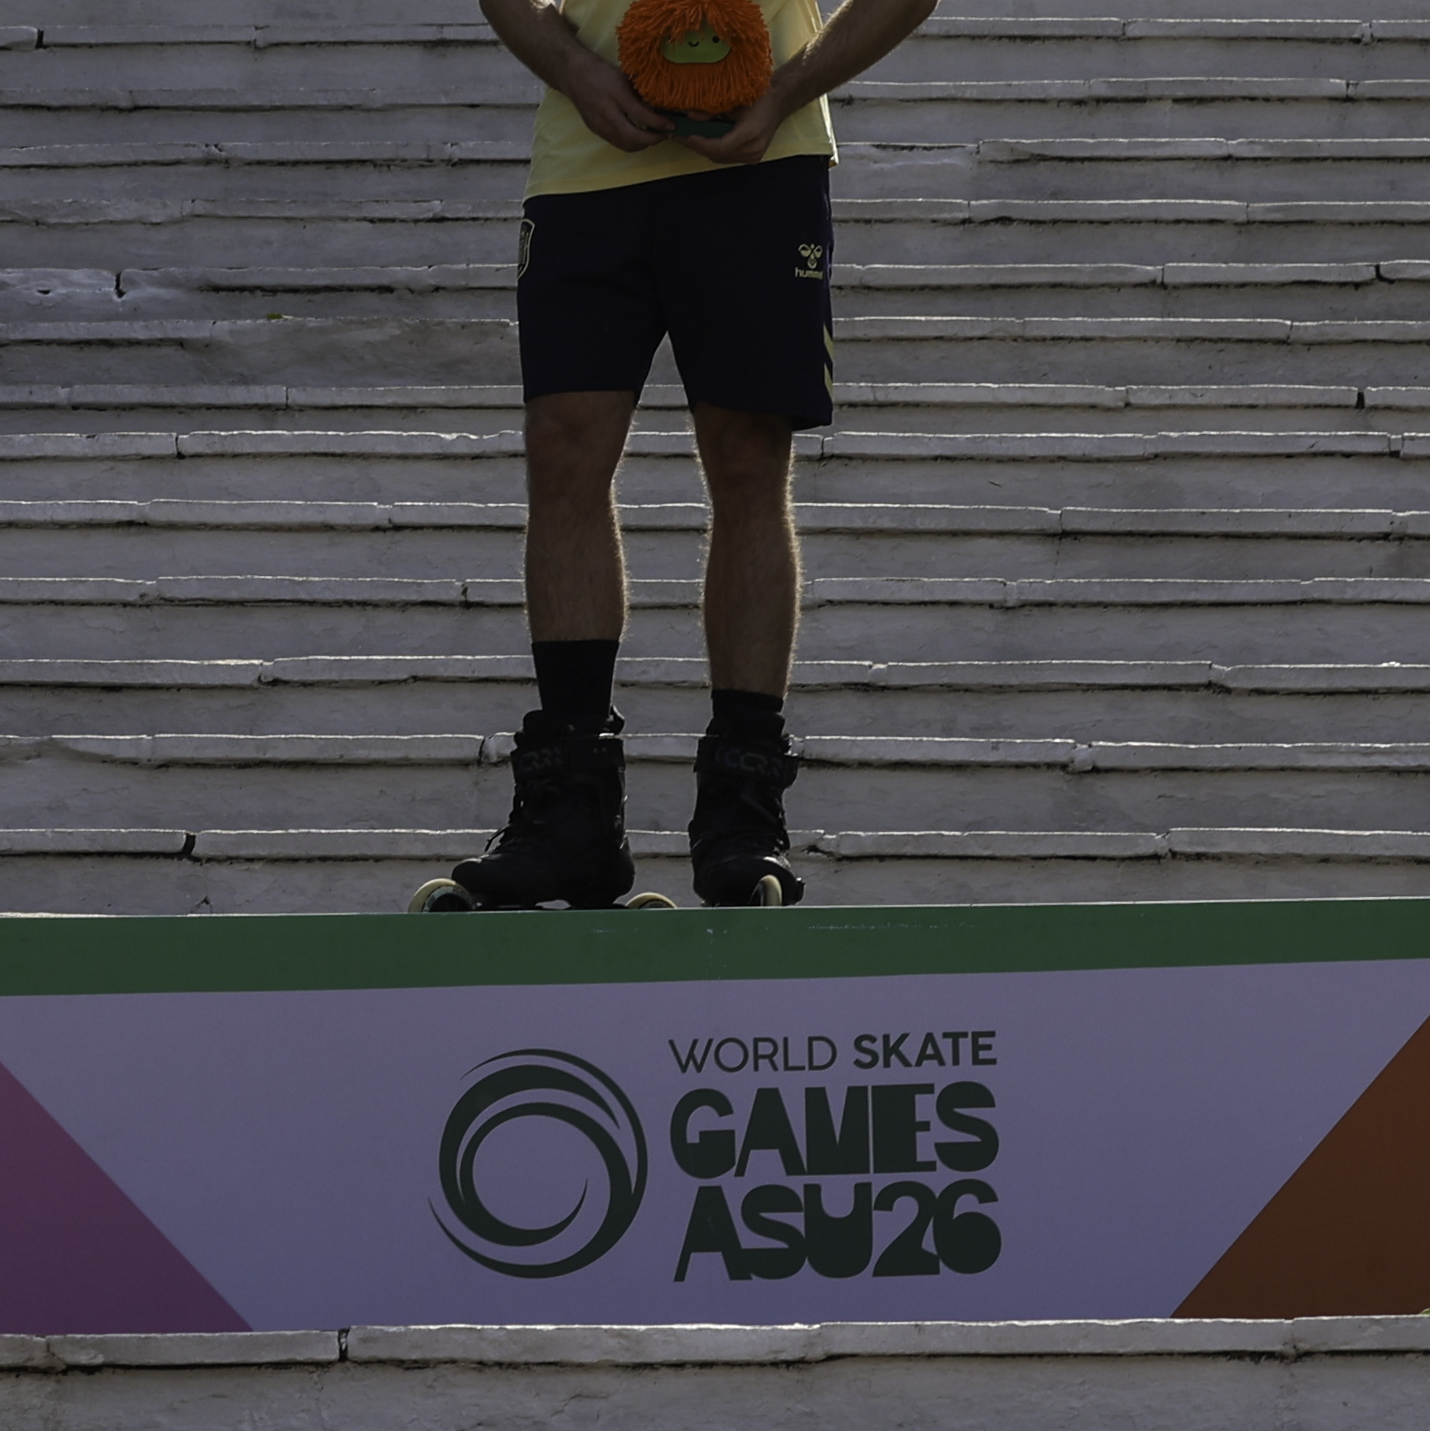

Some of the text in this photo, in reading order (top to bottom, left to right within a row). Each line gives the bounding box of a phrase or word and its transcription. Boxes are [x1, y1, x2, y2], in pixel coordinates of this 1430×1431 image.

[668, 1031, 997, 1074] WORLD SKATE
[670, 1081, 999, 1179] GAMES
[673, 1178, 1002, 1282] ASU26
